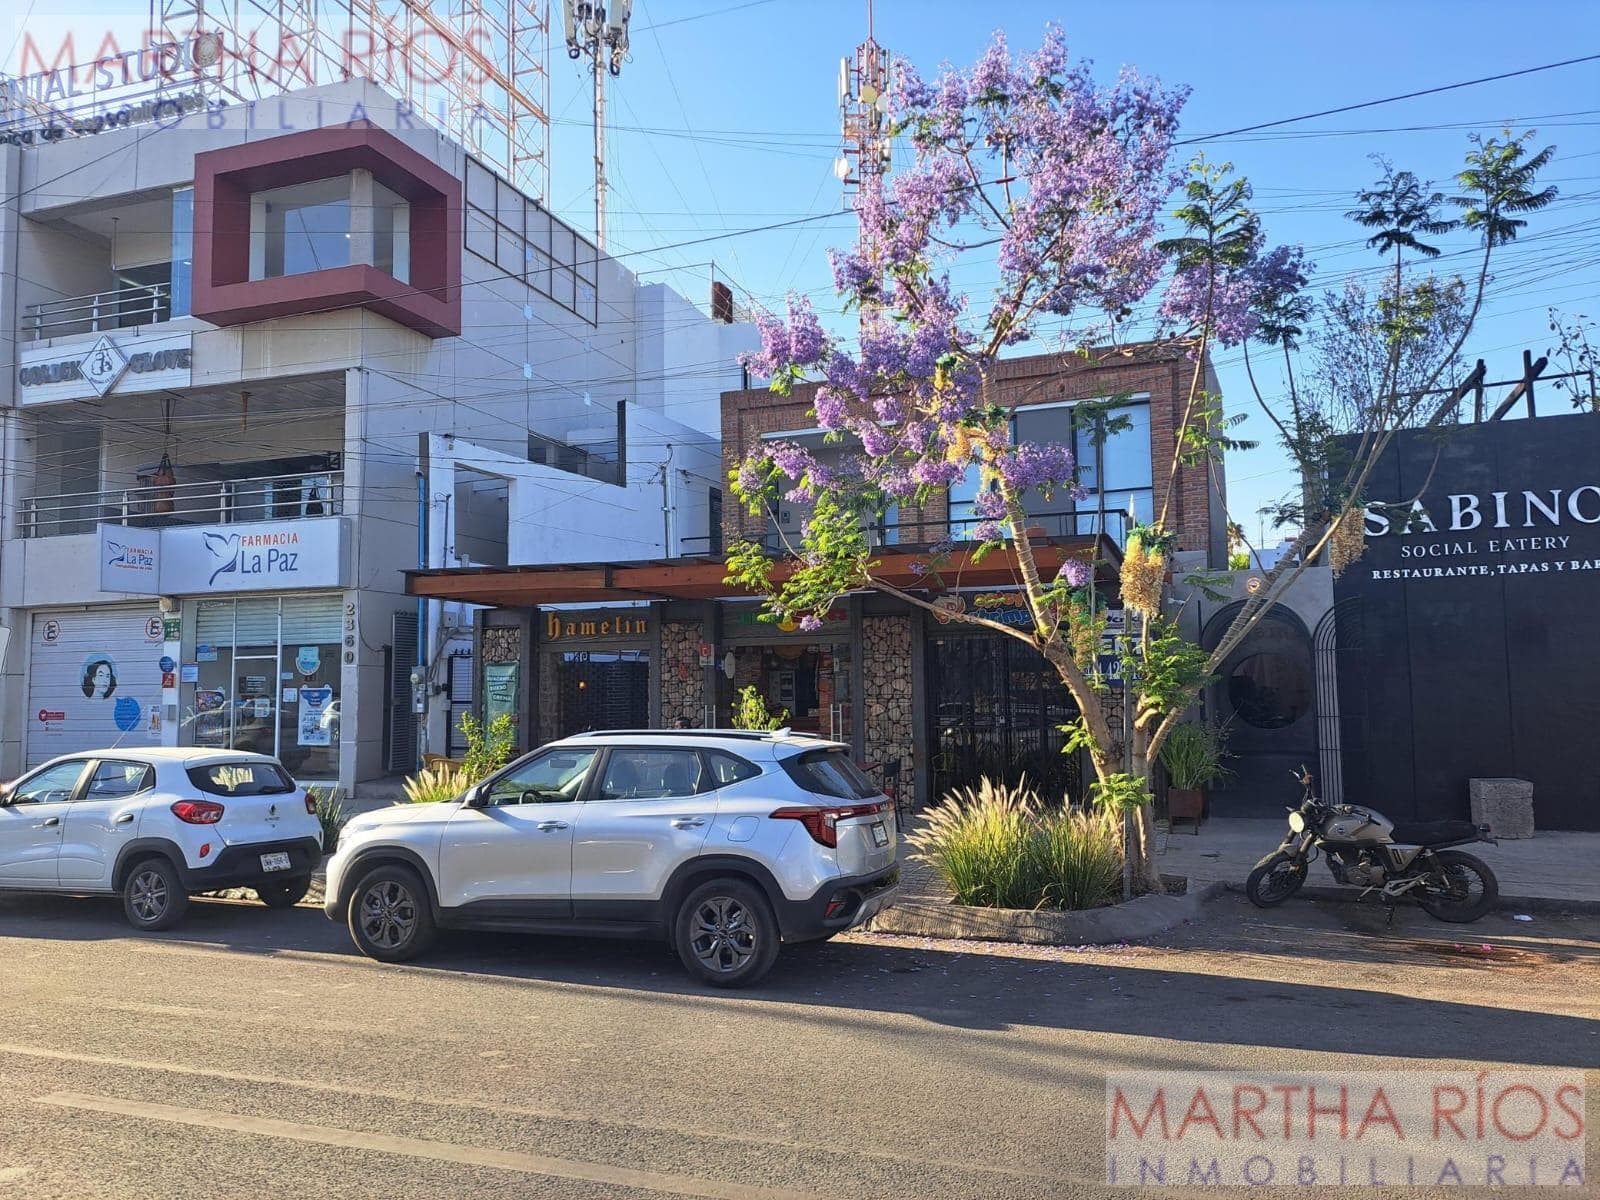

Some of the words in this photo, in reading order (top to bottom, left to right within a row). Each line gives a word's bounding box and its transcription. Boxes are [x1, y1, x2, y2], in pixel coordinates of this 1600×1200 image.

[241, 533, 299, 547] FARMACIA
[1401, 541, 1477, 558] SOCIAL
[1489, 535, 1570, 552] EATERY
[126, 553, 137, 564] La
[138, 554, 153, 566] Paz
[240, 550, 261, 574] La
[267, 548, 298, 573] Paz
[1555, 561, 1565, 572] Y
